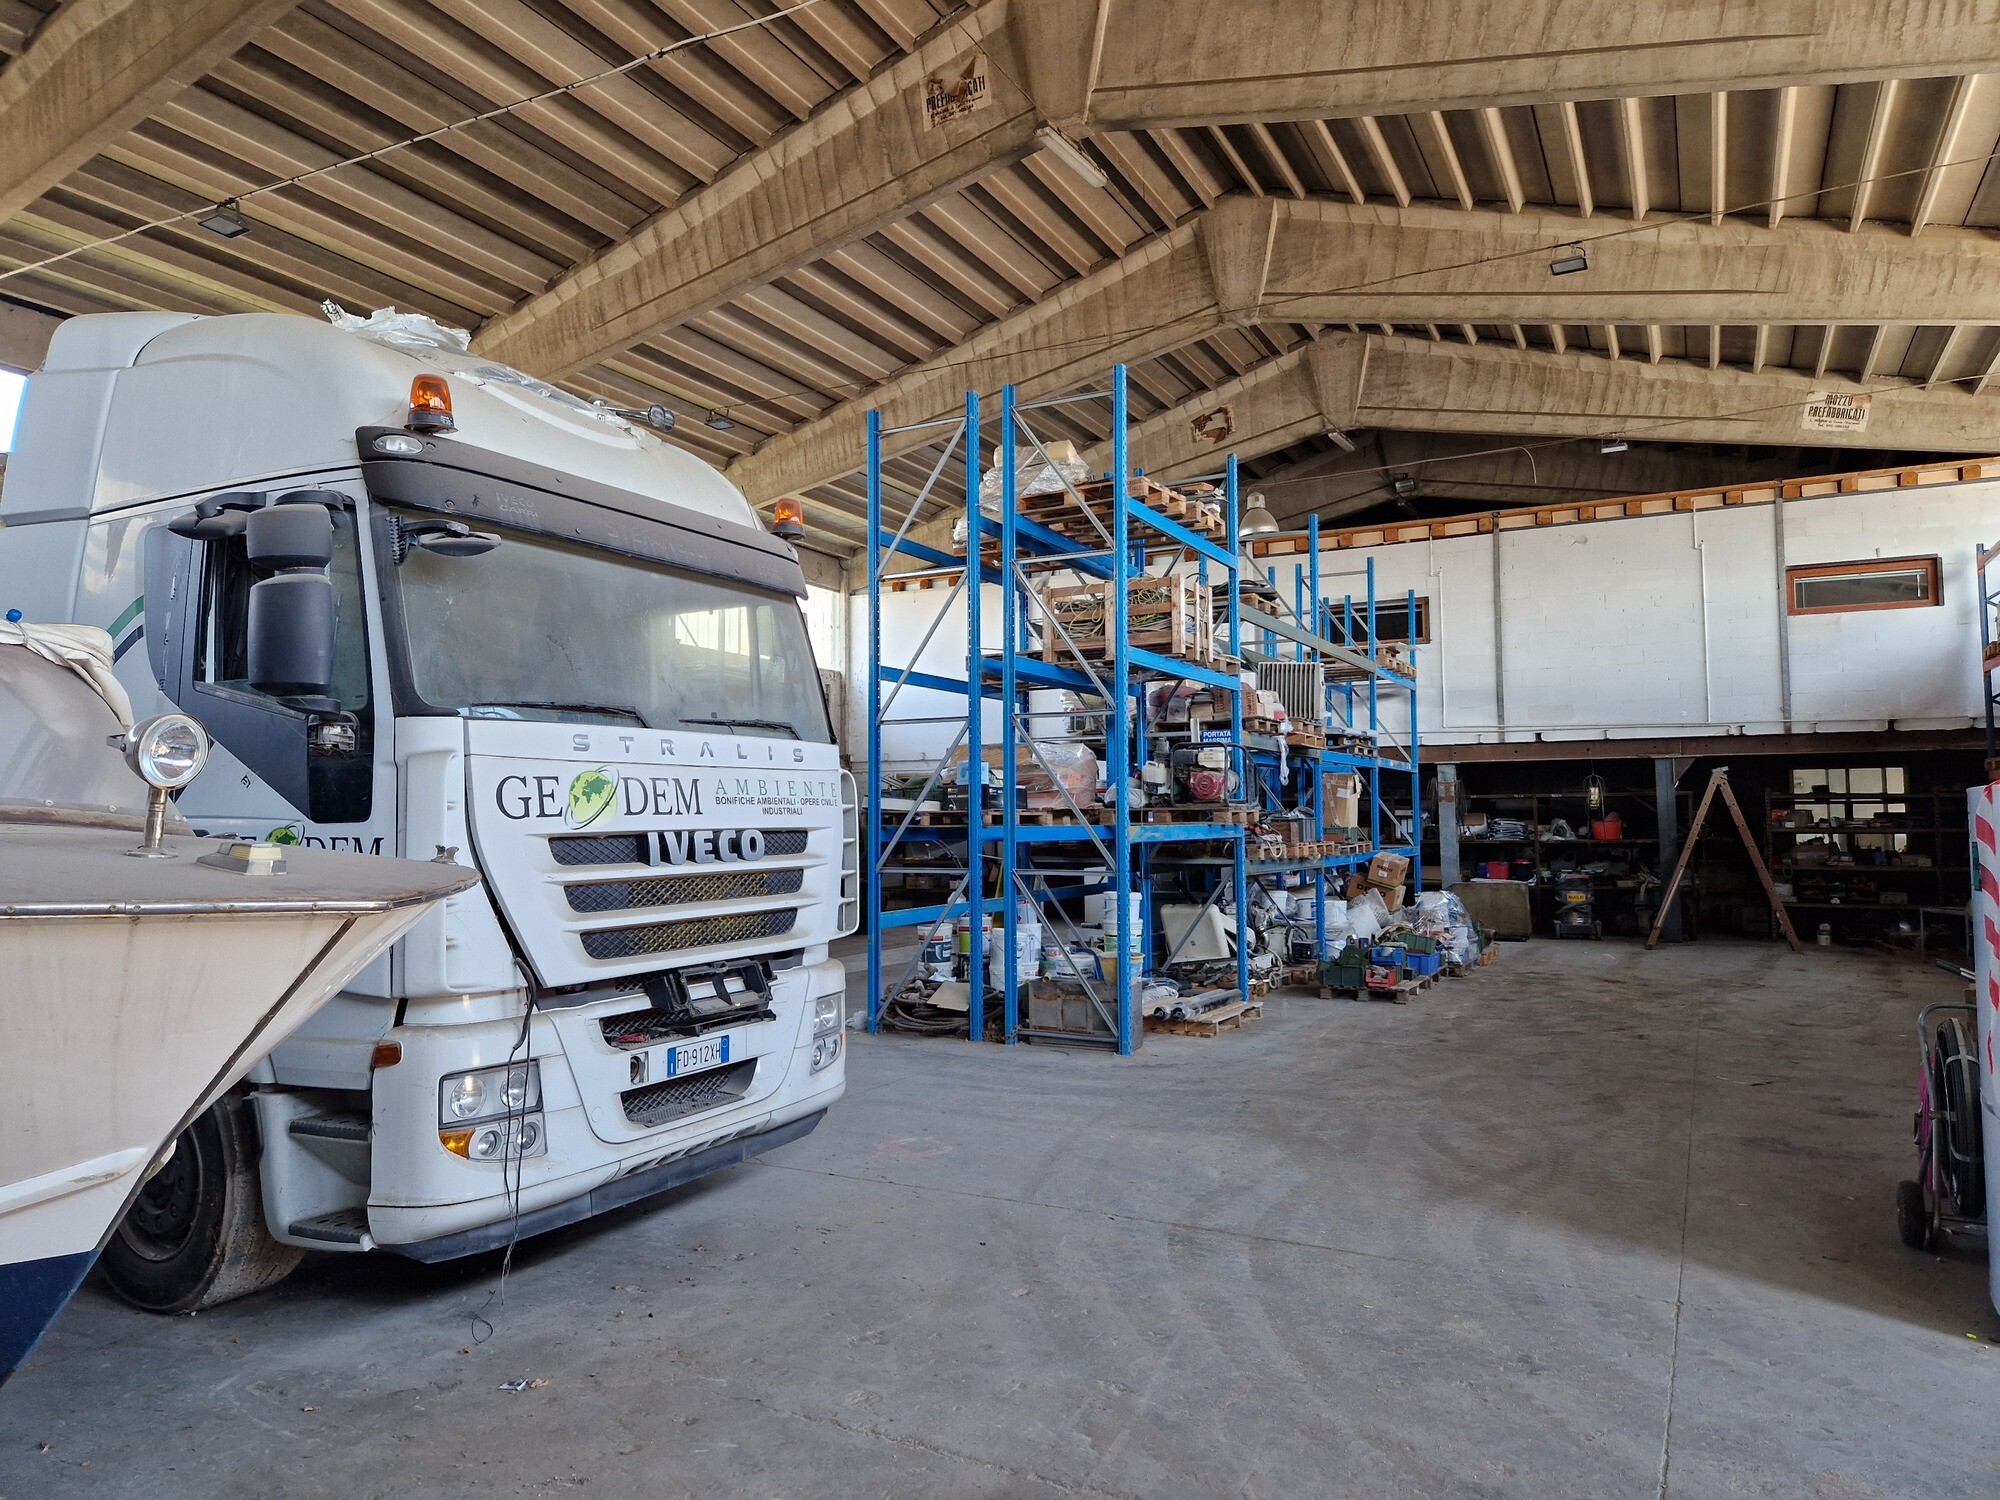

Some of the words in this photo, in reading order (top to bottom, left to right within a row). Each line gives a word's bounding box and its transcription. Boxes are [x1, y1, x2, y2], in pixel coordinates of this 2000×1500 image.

[573, 733, 804, 762] STRALIS
[715, 778, 837, 798] AMBIENTE
[715, 796, 755, 805] BONIFICHE
[757, 797, 796, 806] AMBIENTALI
[800, 798, 820, 806] OPERE
[762, 807, 803, 815] INDUSTRIALI
[647, 828, 765, 867] IVECO
